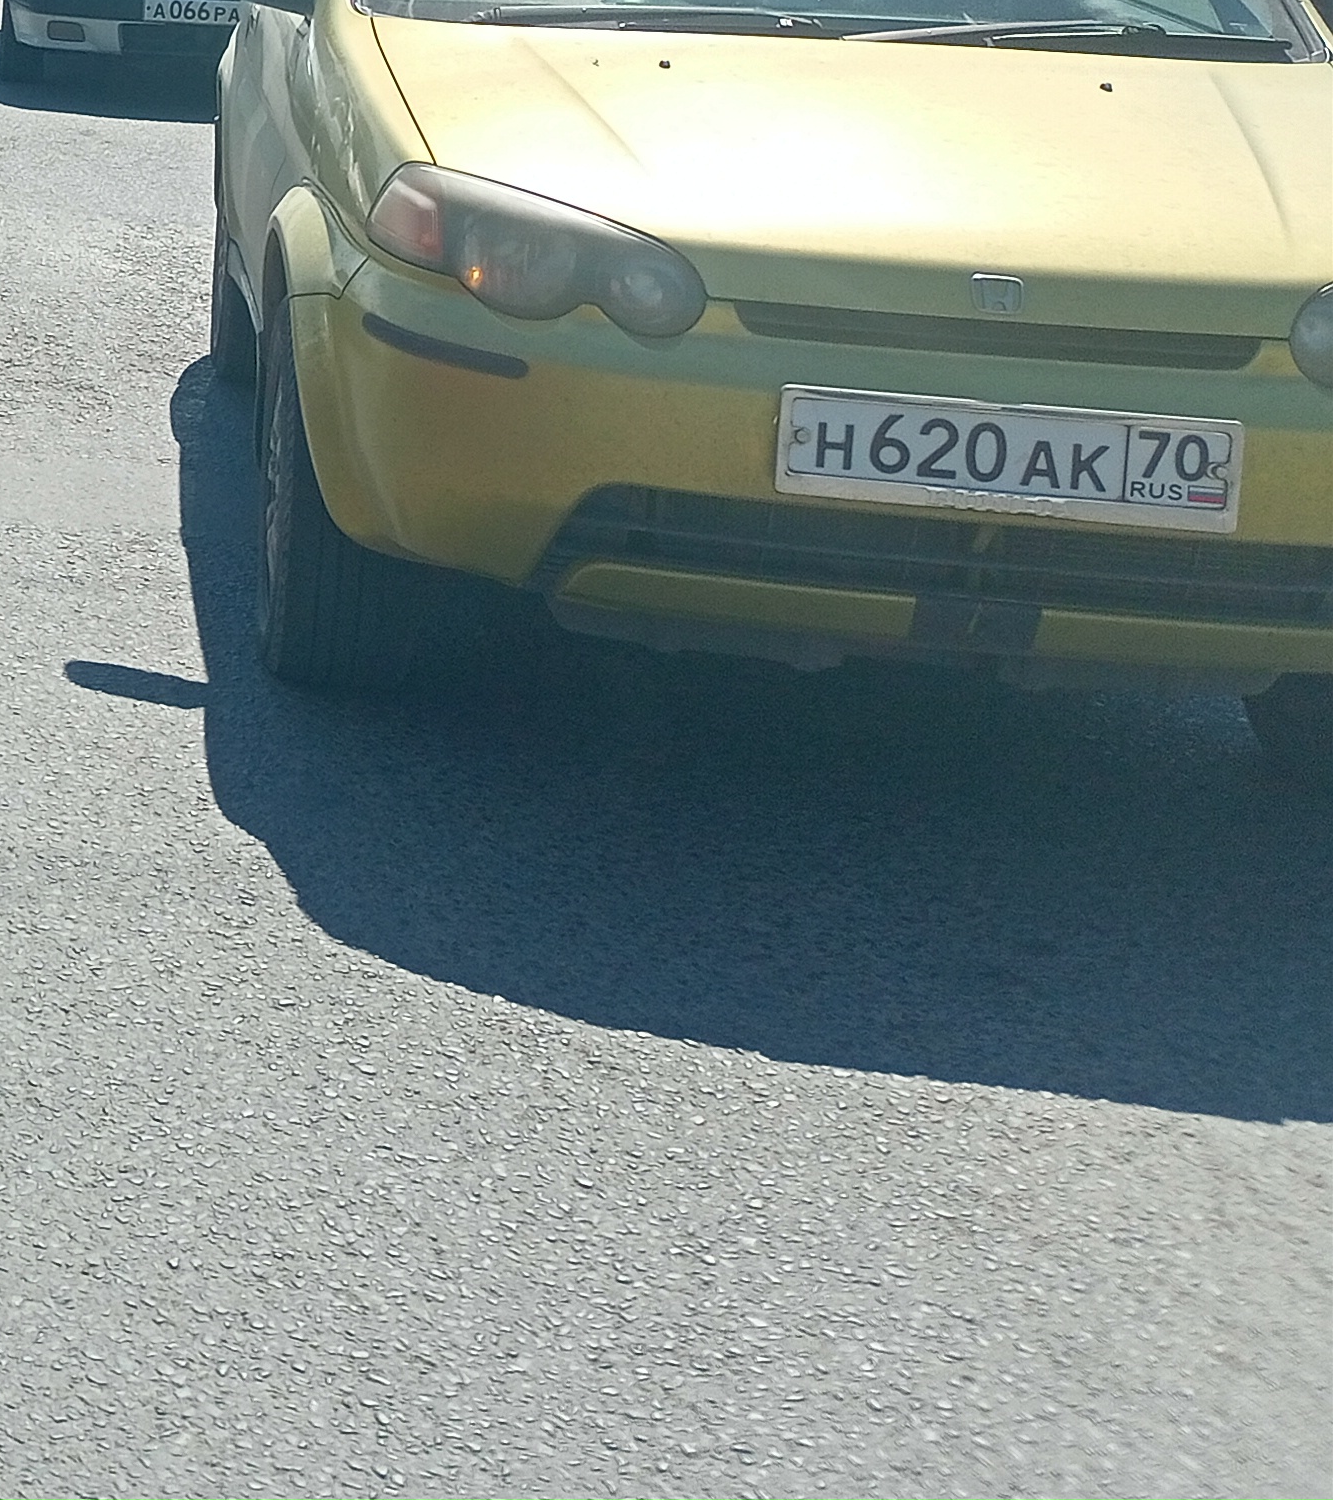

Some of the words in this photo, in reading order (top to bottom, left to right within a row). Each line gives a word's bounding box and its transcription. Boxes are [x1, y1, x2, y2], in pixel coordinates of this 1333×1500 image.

[153, 0, 241, 23] А066РА
[814, 413, 1111, 494] Н620АК
[1137, 430, 1210, 482] 70
[1129, 480, 1184, 502] RUS
